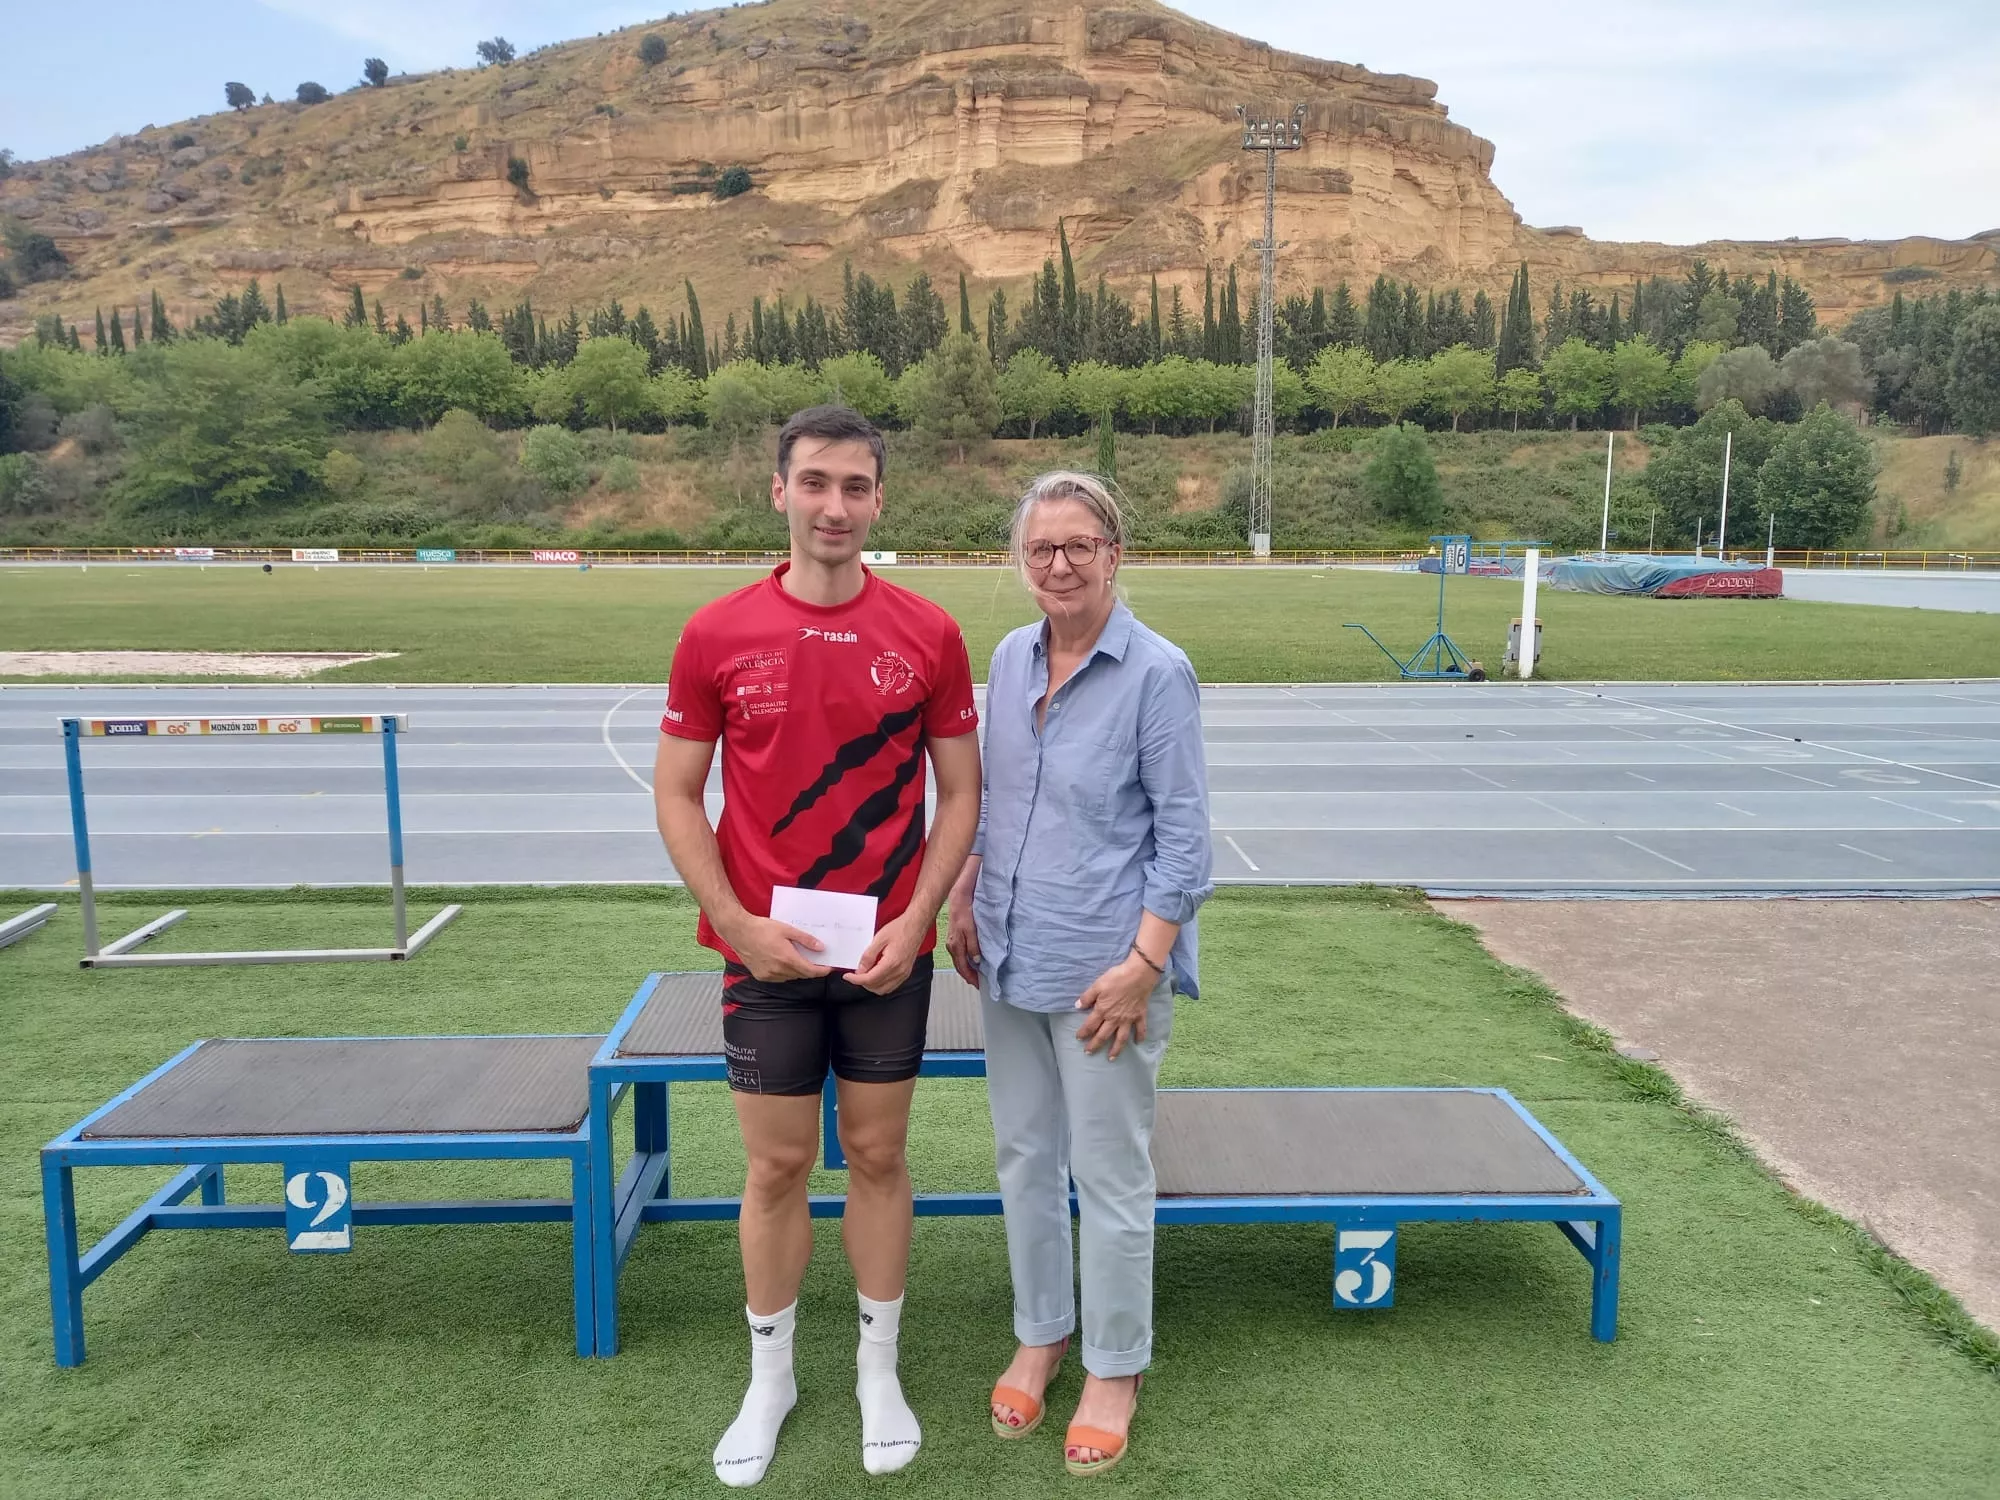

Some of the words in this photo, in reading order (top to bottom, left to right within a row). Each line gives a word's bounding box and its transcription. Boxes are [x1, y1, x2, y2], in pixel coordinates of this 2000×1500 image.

[823, 629, 858, 643] rasán
[749, 700, 789, 710] GENERALITAT
[167, 724, 186, 734] GO
[242, 723, 258, 731] 2021
[278, 723, 297, 732] GO
[286, 1171, 350, 1250] 2
[1335, 1230, 1394, 1304] 3
